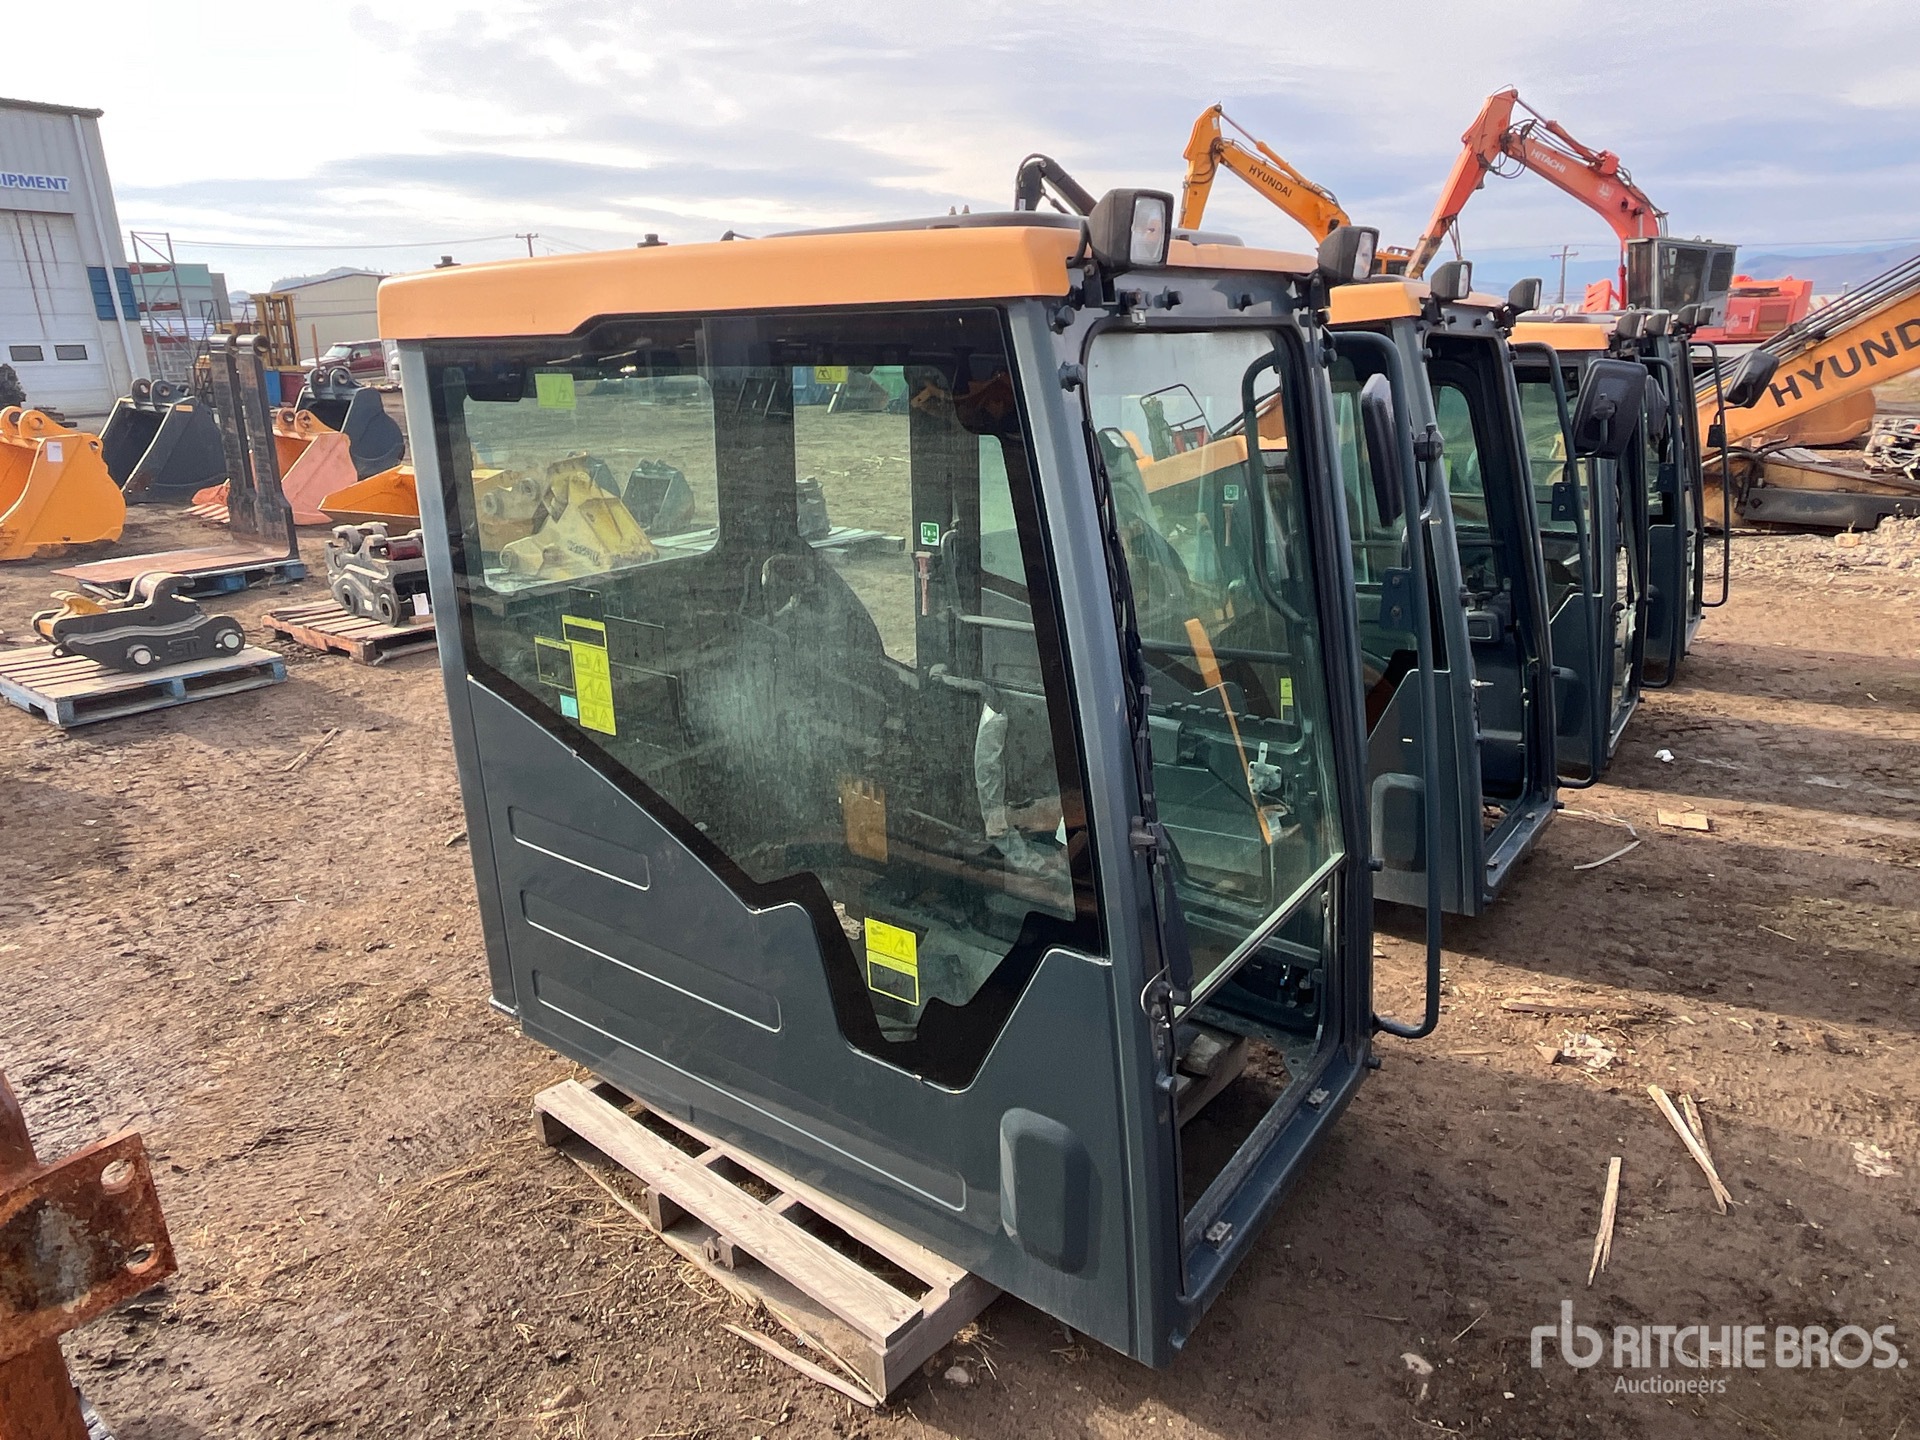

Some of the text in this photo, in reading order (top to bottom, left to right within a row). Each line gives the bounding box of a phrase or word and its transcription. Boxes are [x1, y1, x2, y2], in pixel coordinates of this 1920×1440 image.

[1530, 148, 1566, 174] HITACHI
[0, 173, 68, 190] IPMENT
[1248, 164, 1293, 198] HYUNDAI
